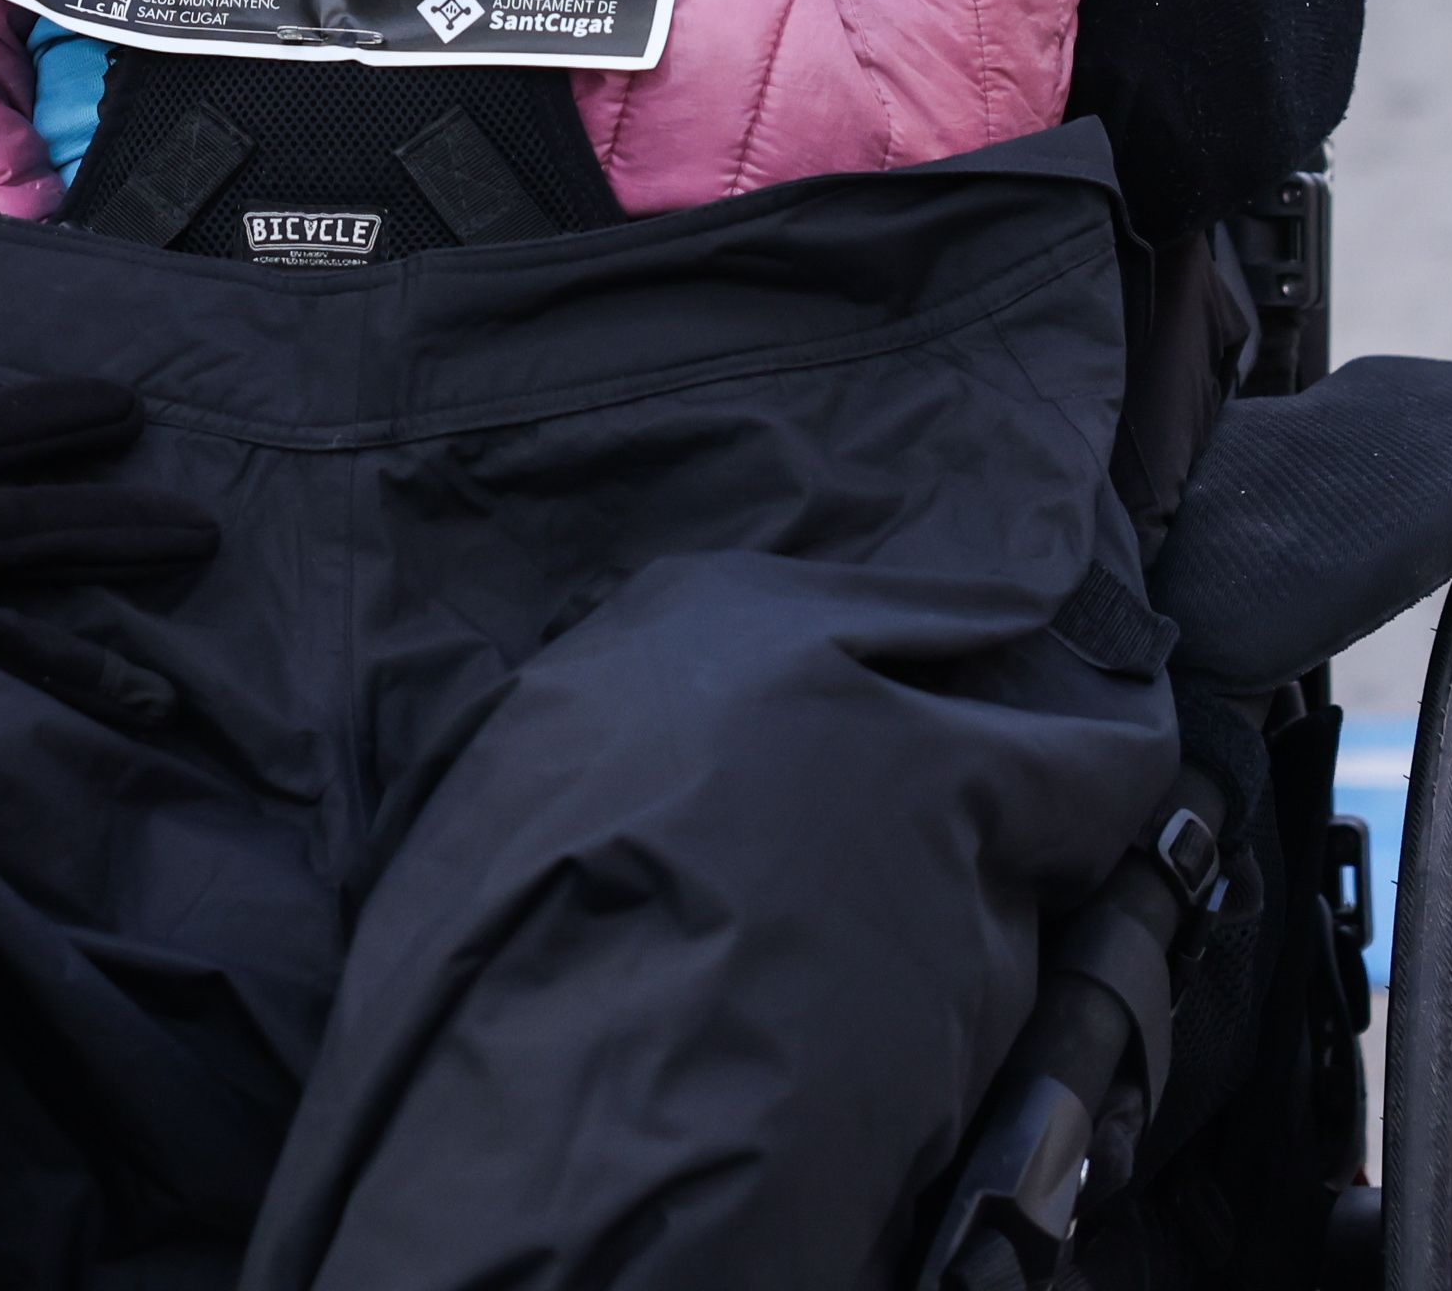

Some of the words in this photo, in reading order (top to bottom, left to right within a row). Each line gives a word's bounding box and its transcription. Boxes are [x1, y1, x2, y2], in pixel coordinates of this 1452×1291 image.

[136, 5, 176, 22] SANT
[179, 10, 230, 26] CUGAT
[597, 0, 618, 15] DE
[489, 10, 615, 38] SantCugat
[252, 217, 370, 244] BICYCLE
